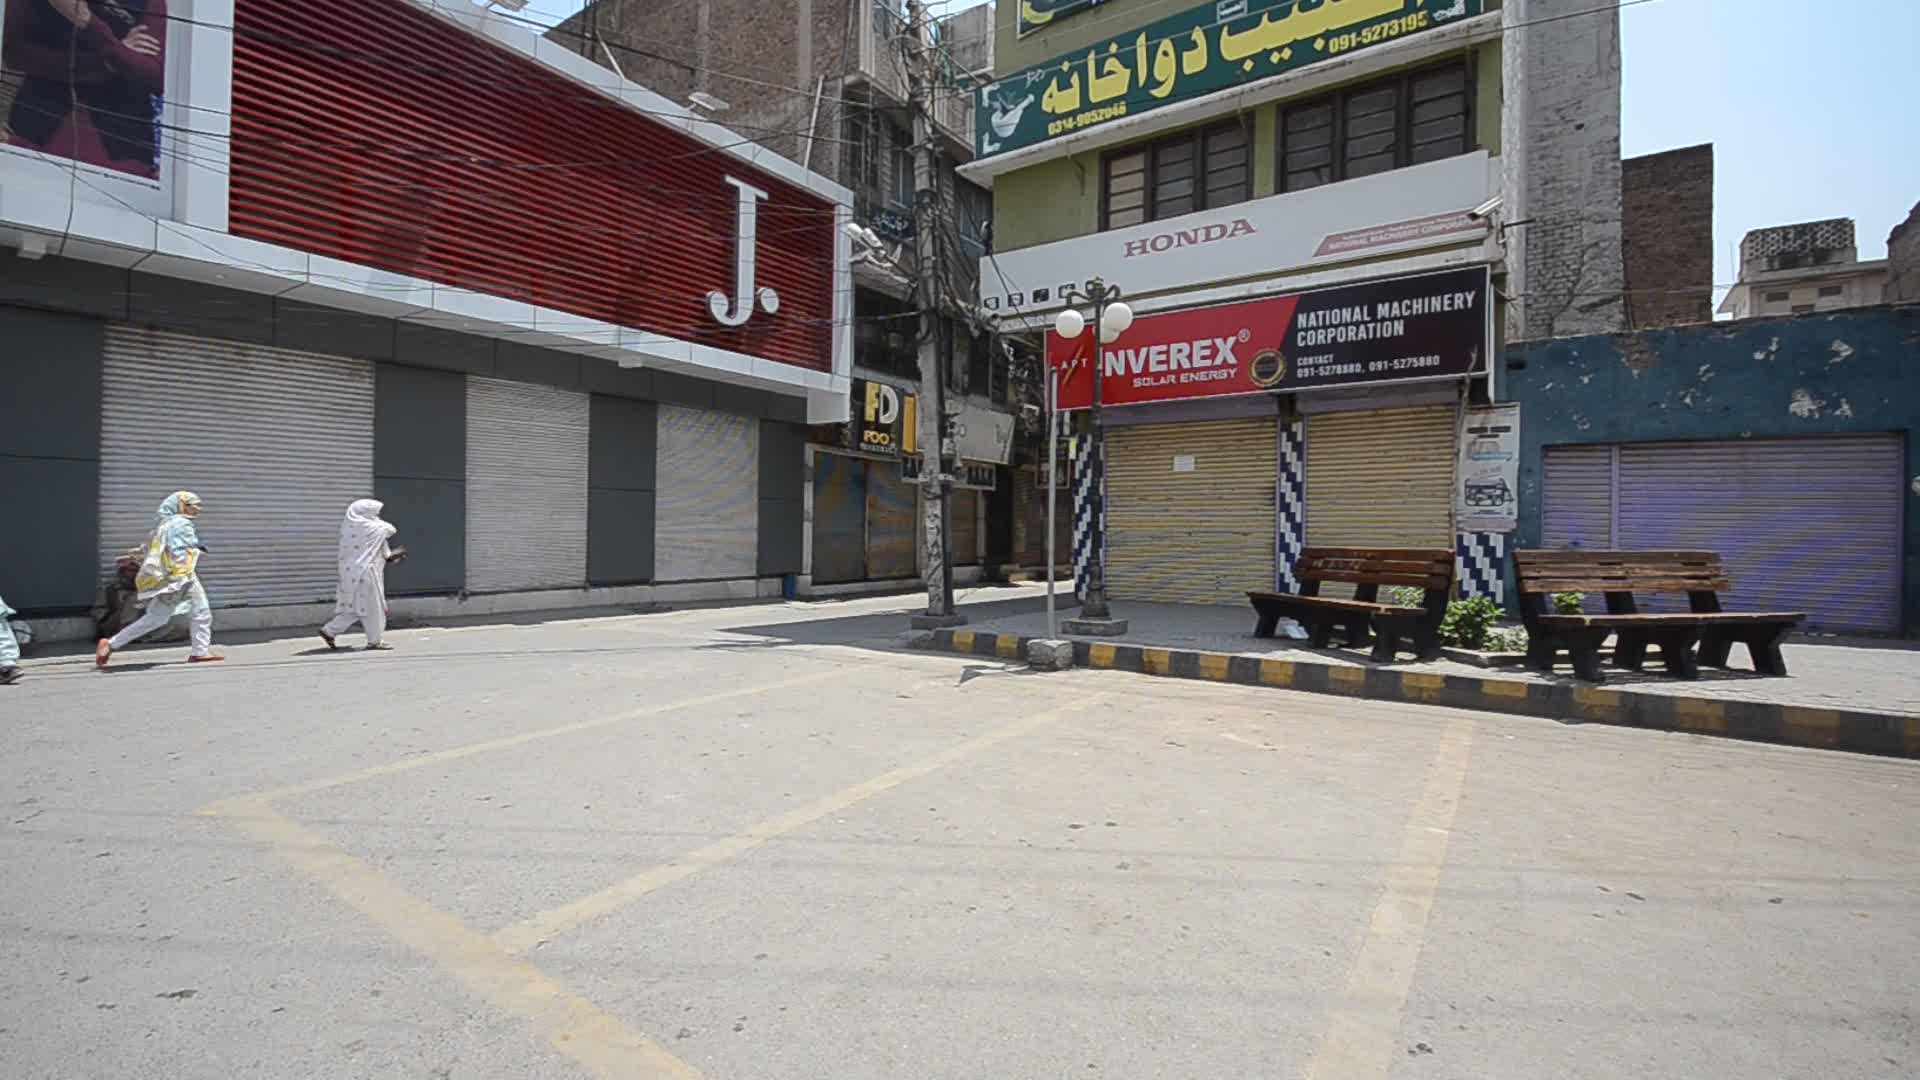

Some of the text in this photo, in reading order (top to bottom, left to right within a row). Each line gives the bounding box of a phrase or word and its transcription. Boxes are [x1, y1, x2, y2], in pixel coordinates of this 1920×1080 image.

[1329, 10, 1428, 53] 091-5273195
[1123, 218, 1257, 257] HONDA
[1297, 291, 1476, 329] NATIONAL MACHINERY
[1297, 320, 1404, 347] CORPORATION
[1133, 368, 1238, 388] SOLAR ENERGY
